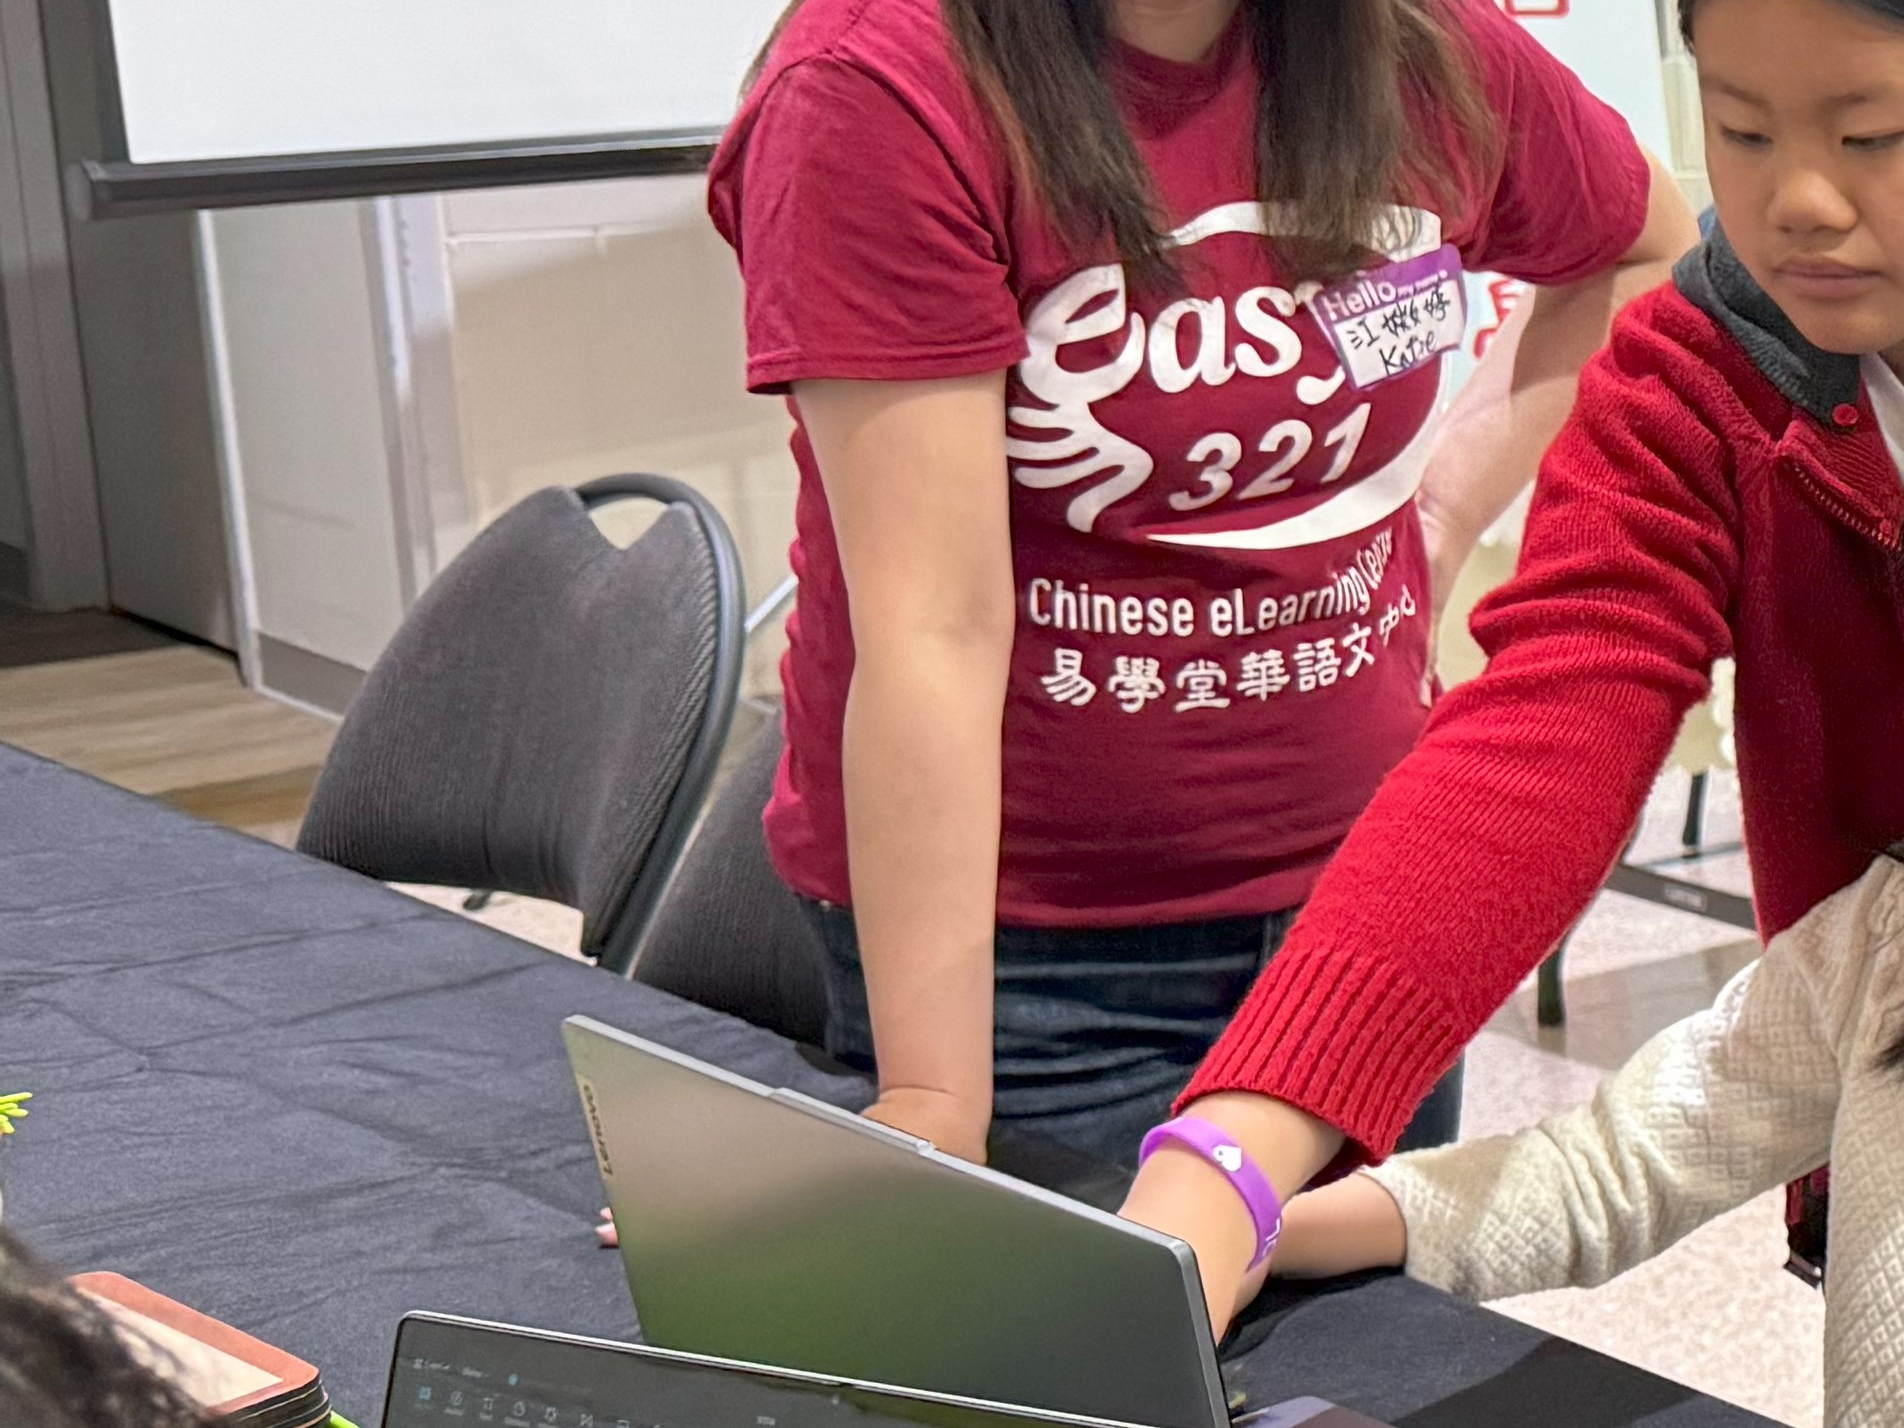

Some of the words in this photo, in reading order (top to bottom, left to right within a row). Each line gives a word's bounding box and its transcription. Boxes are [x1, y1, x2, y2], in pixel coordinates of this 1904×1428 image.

[1321, 280, 1397, 321] Hello
[1379, 330, 1437, 378] Katie
[1168, 402, 1372, 512] 321
[1028, 576, 1195, 637] Chinese
[1210, 568, 1371, 637] eLearning
[582, 1083, 614, 1177] Lenovo
